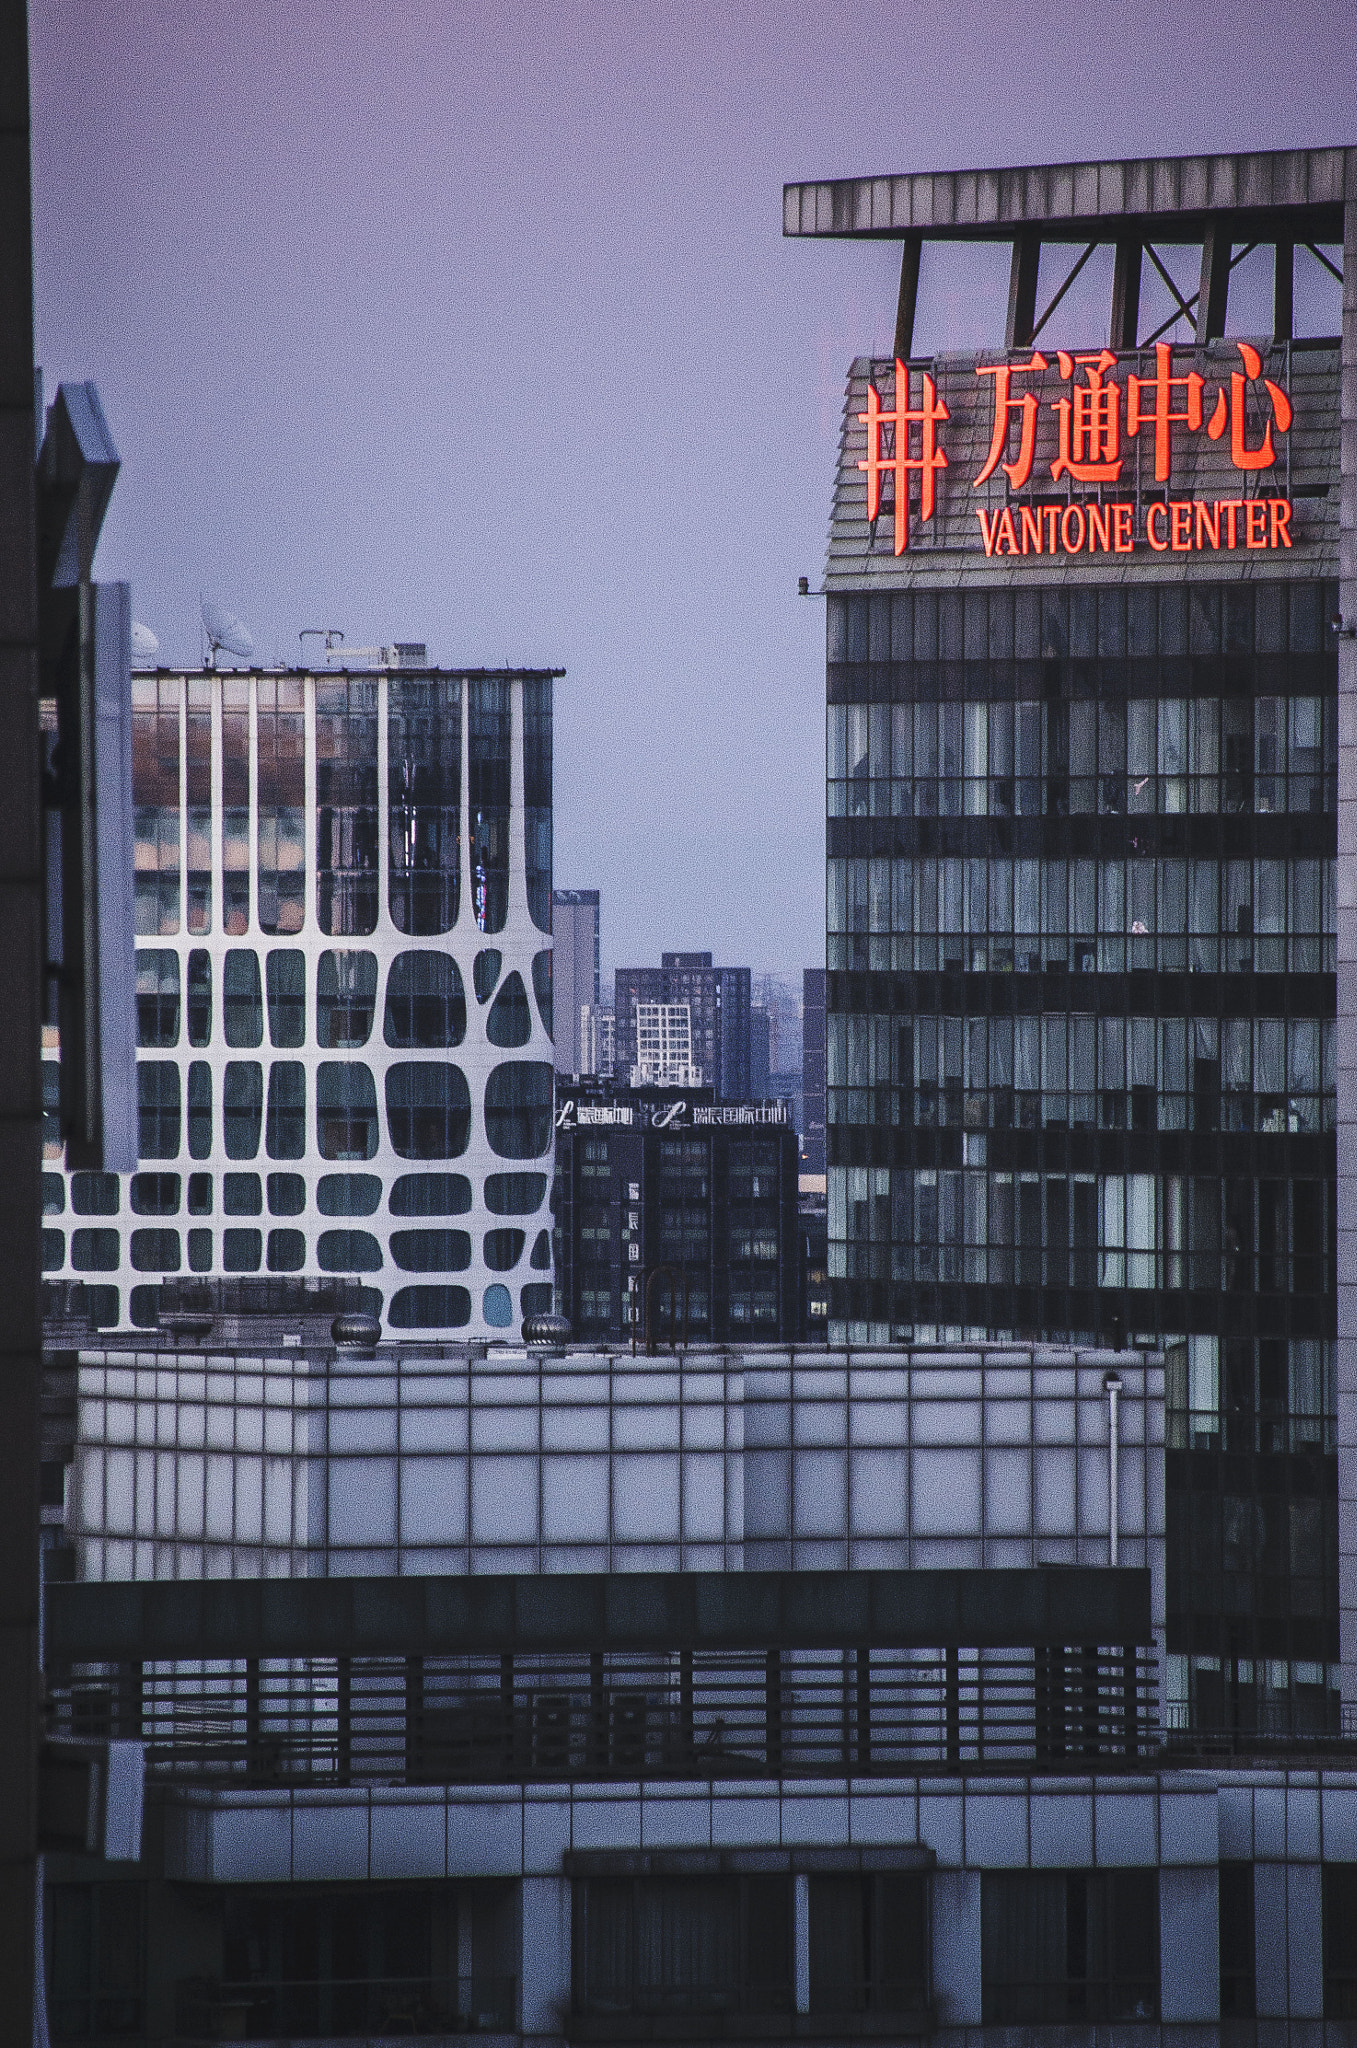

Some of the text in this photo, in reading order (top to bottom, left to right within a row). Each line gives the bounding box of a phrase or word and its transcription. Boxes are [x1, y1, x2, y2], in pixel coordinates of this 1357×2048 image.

[973, 342, 1292, 490] 万通中心
[976, 499, 1293, 558] VANTONE CENTER
